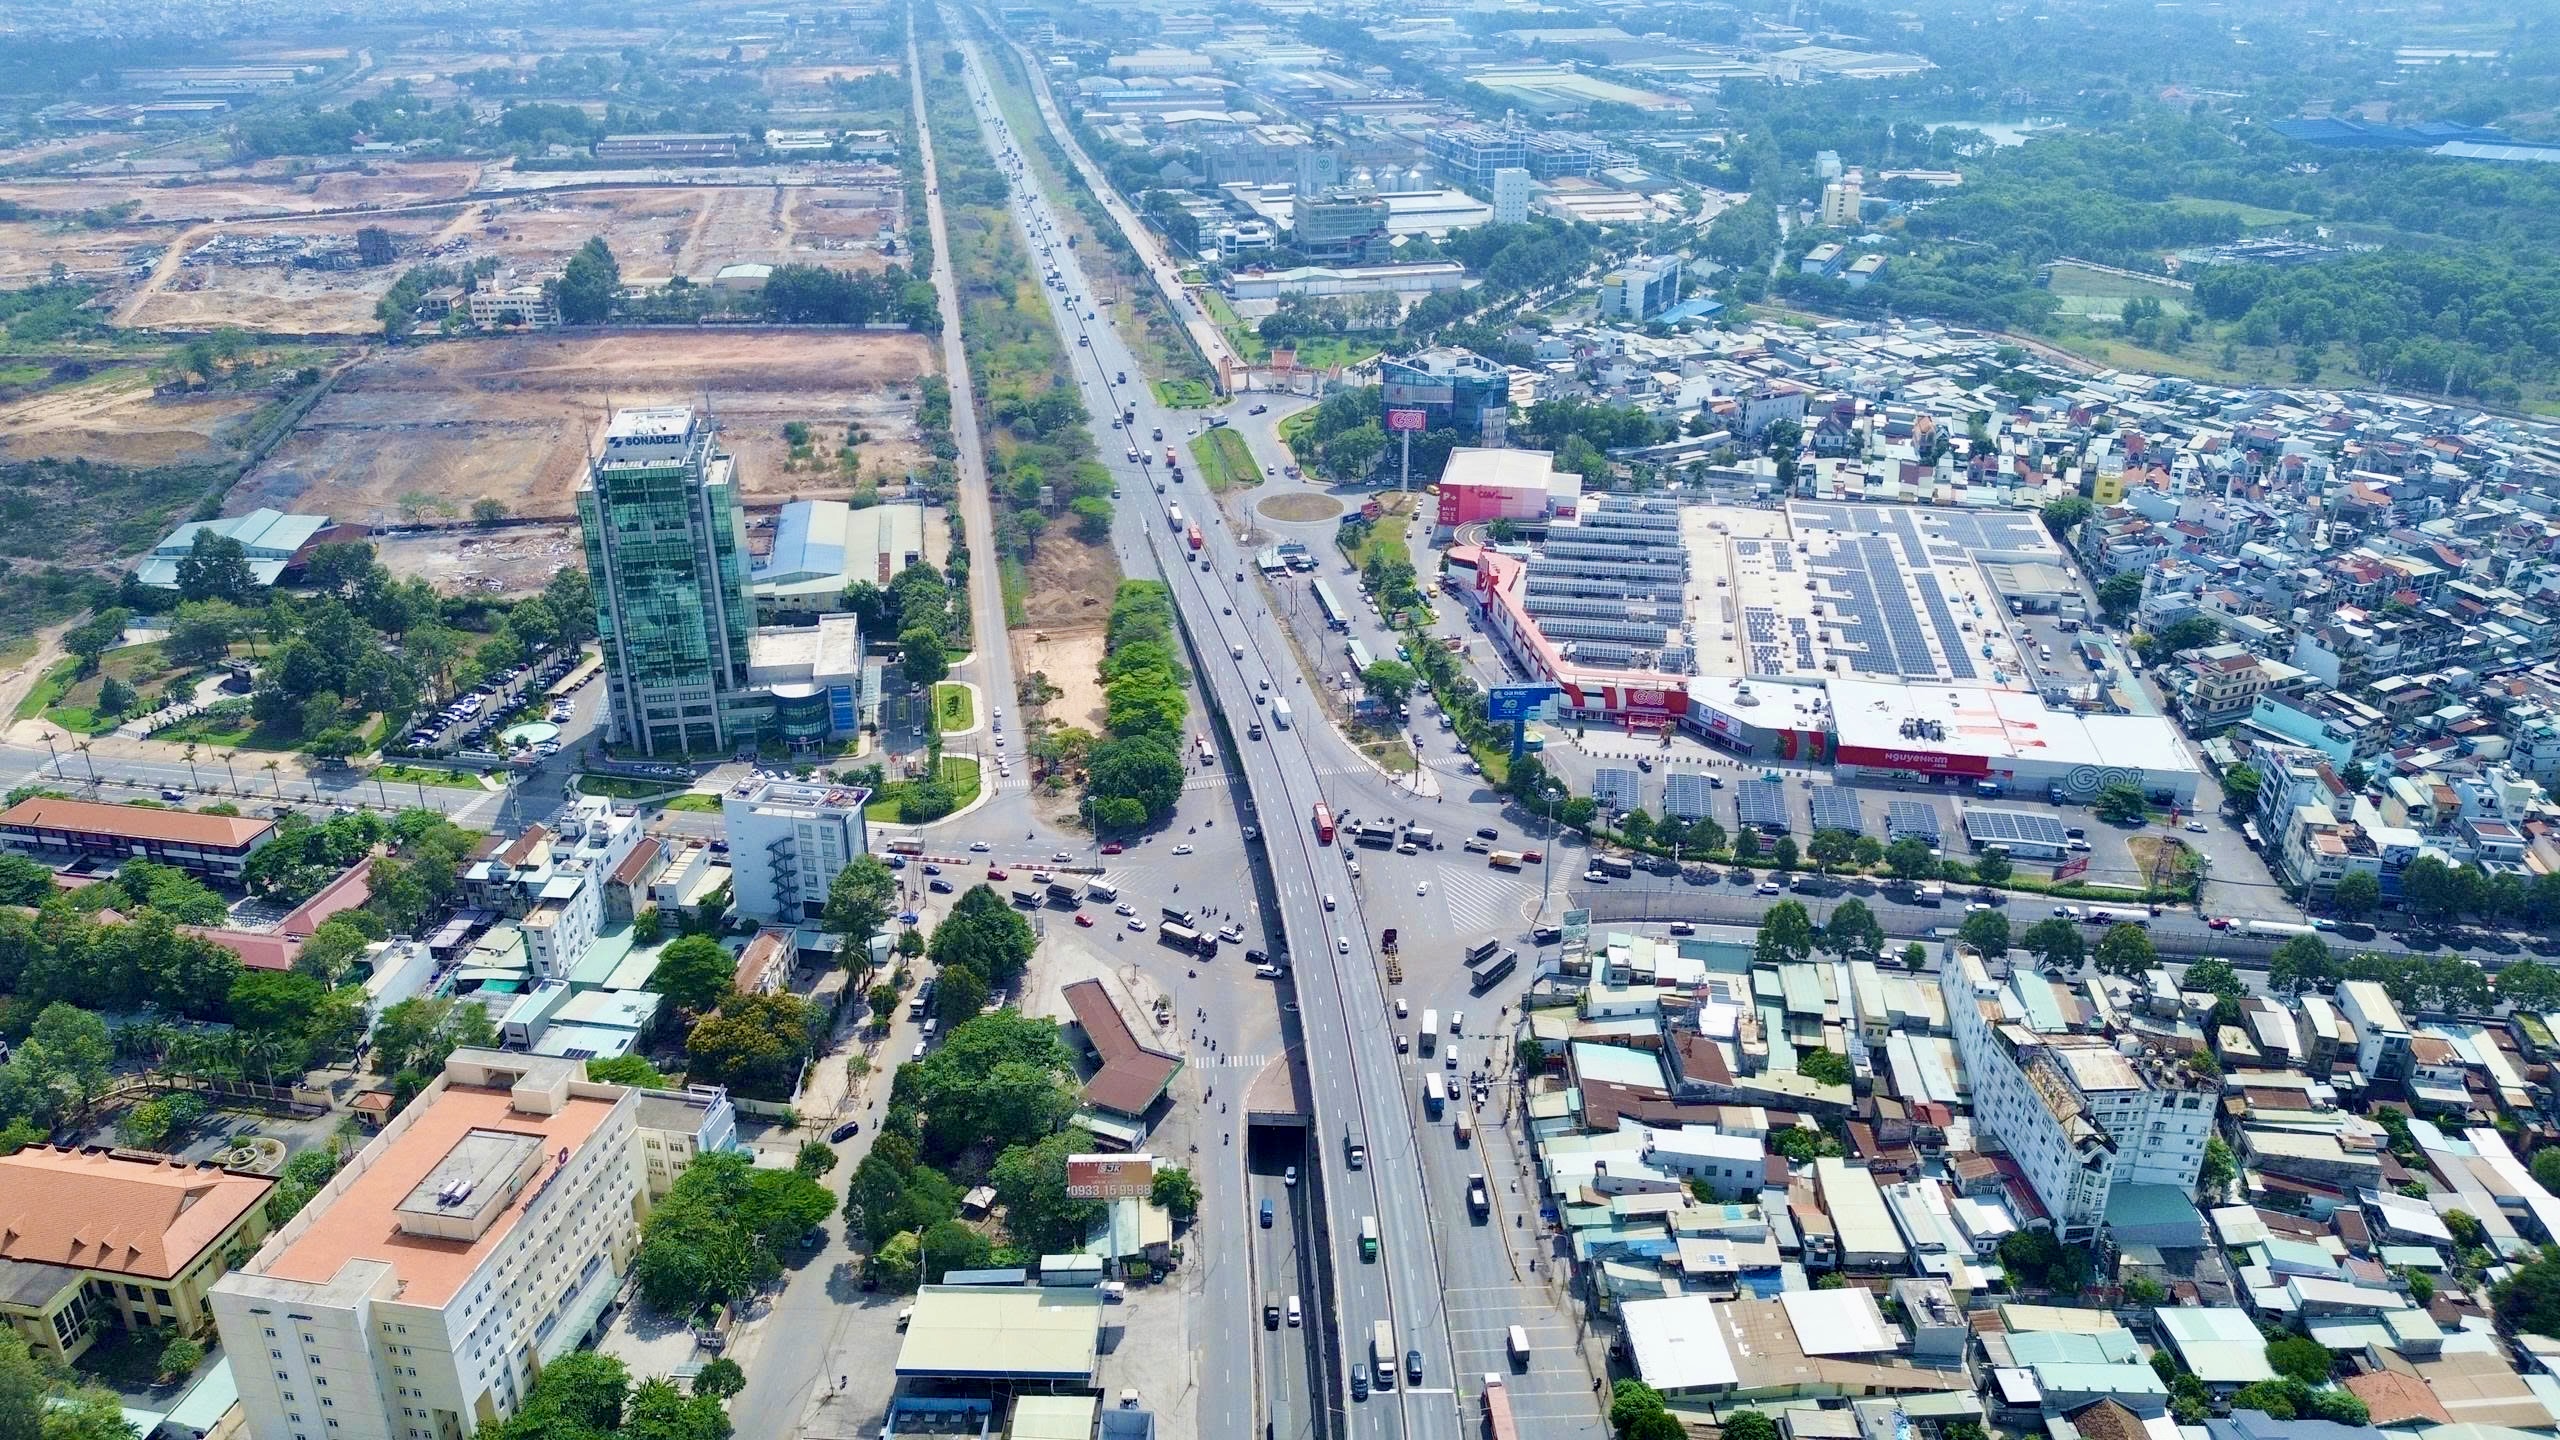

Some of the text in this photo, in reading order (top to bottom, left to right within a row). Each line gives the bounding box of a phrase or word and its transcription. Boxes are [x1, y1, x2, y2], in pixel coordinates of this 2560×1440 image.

[1392, 412, 1422, 429] GO!
[625, 435, 681, 446] SONADEZI
[1633, 690, 1665, 706] GO!
[1071, 1185, 1099, 1196] 0933
[1120, 1185, 1134, 1195] 99
[1136, 1184, 1151, 1195] 88
